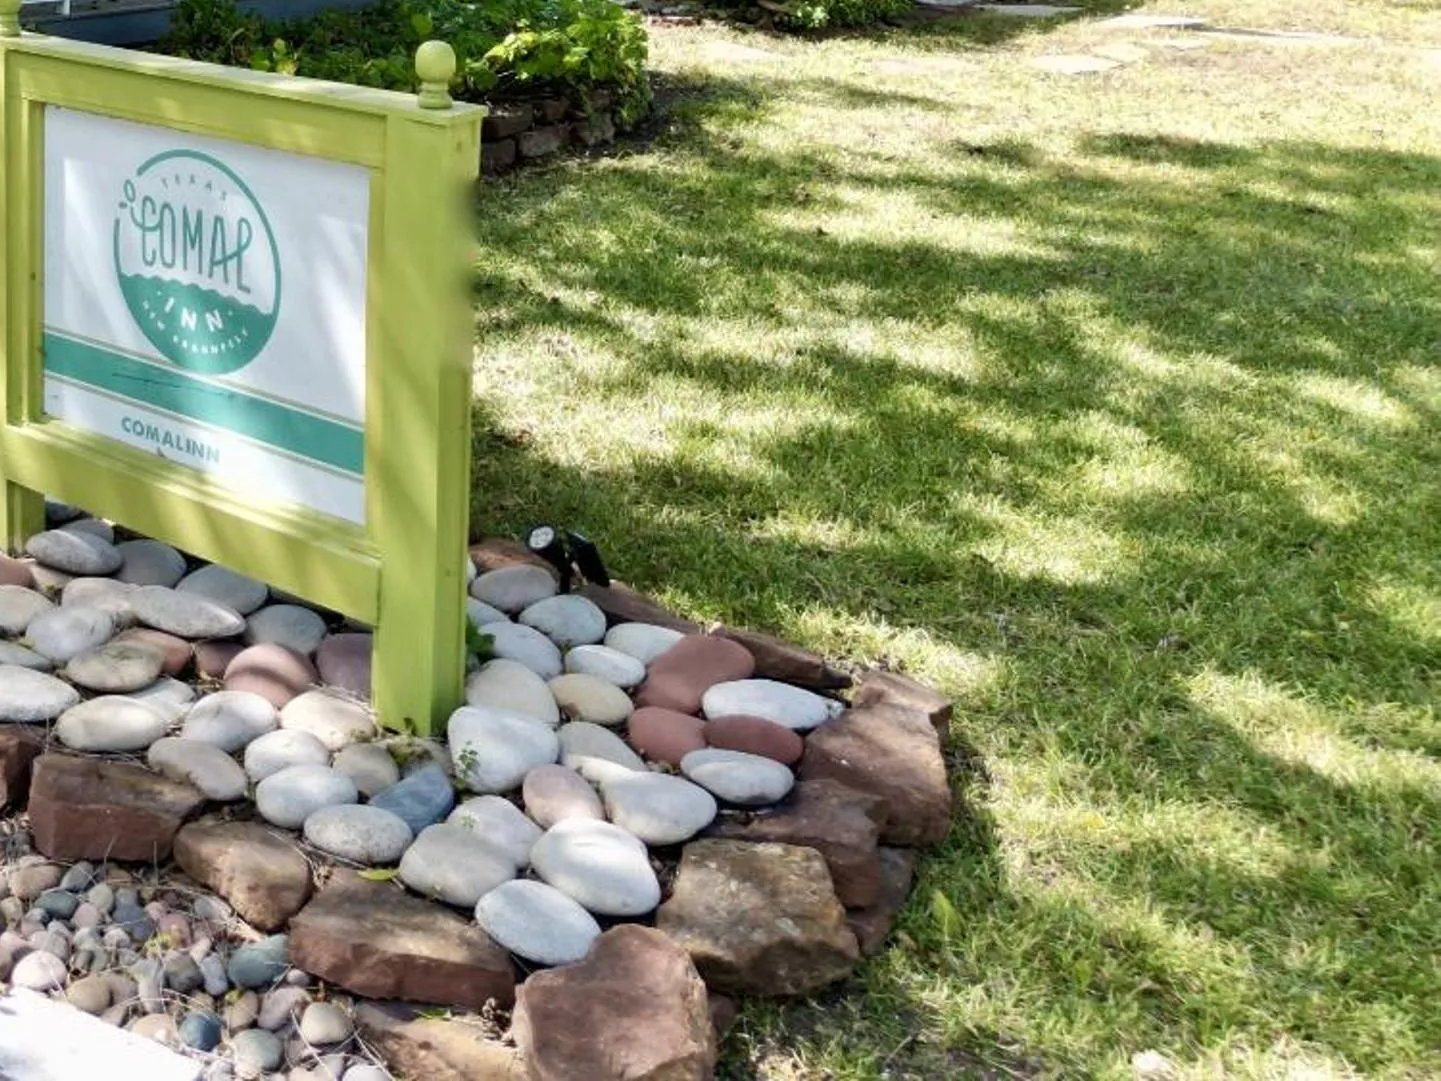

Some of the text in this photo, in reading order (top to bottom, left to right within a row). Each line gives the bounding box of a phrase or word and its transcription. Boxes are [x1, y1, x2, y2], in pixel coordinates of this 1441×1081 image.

[130, 195, 253, 294] COMAL
[164, 296, 224, 332] INN
[121, 416, 220, 463] COMALINN
